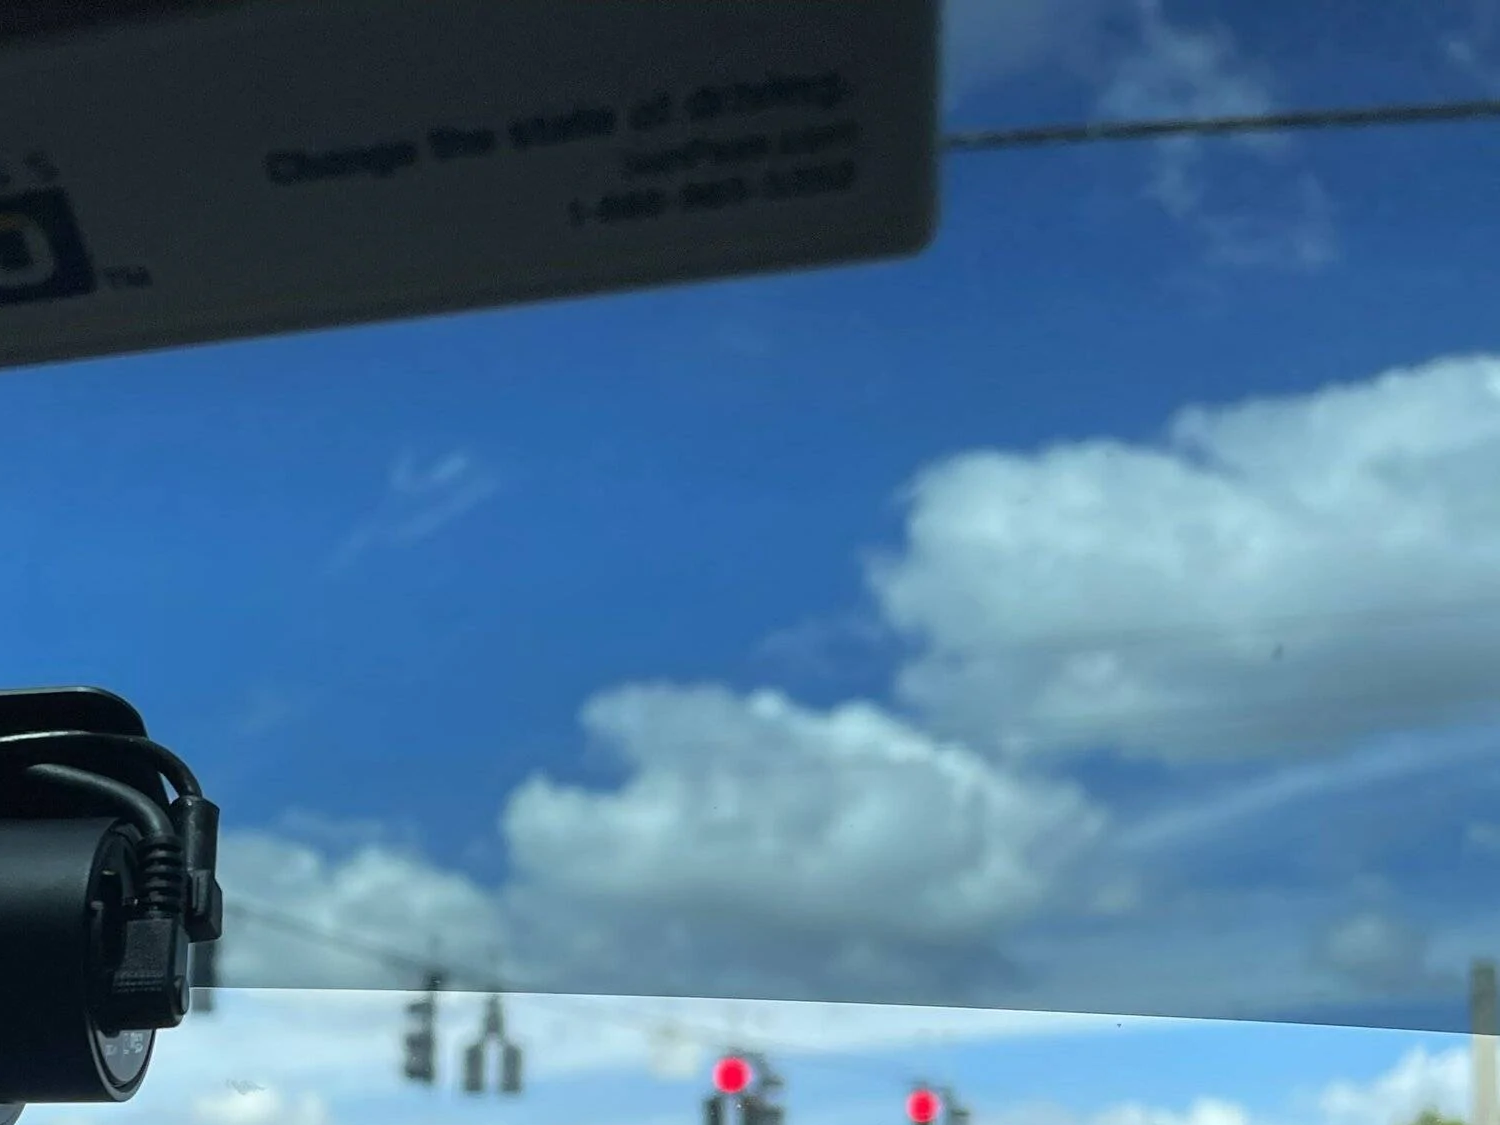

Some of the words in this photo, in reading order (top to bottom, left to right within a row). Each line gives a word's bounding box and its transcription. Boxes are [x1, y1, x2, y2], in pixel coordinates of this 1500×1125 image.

[265, 140, 417, 185] Change
[426, 127, 497, 161] the
[629, 90, 671, 130] of
